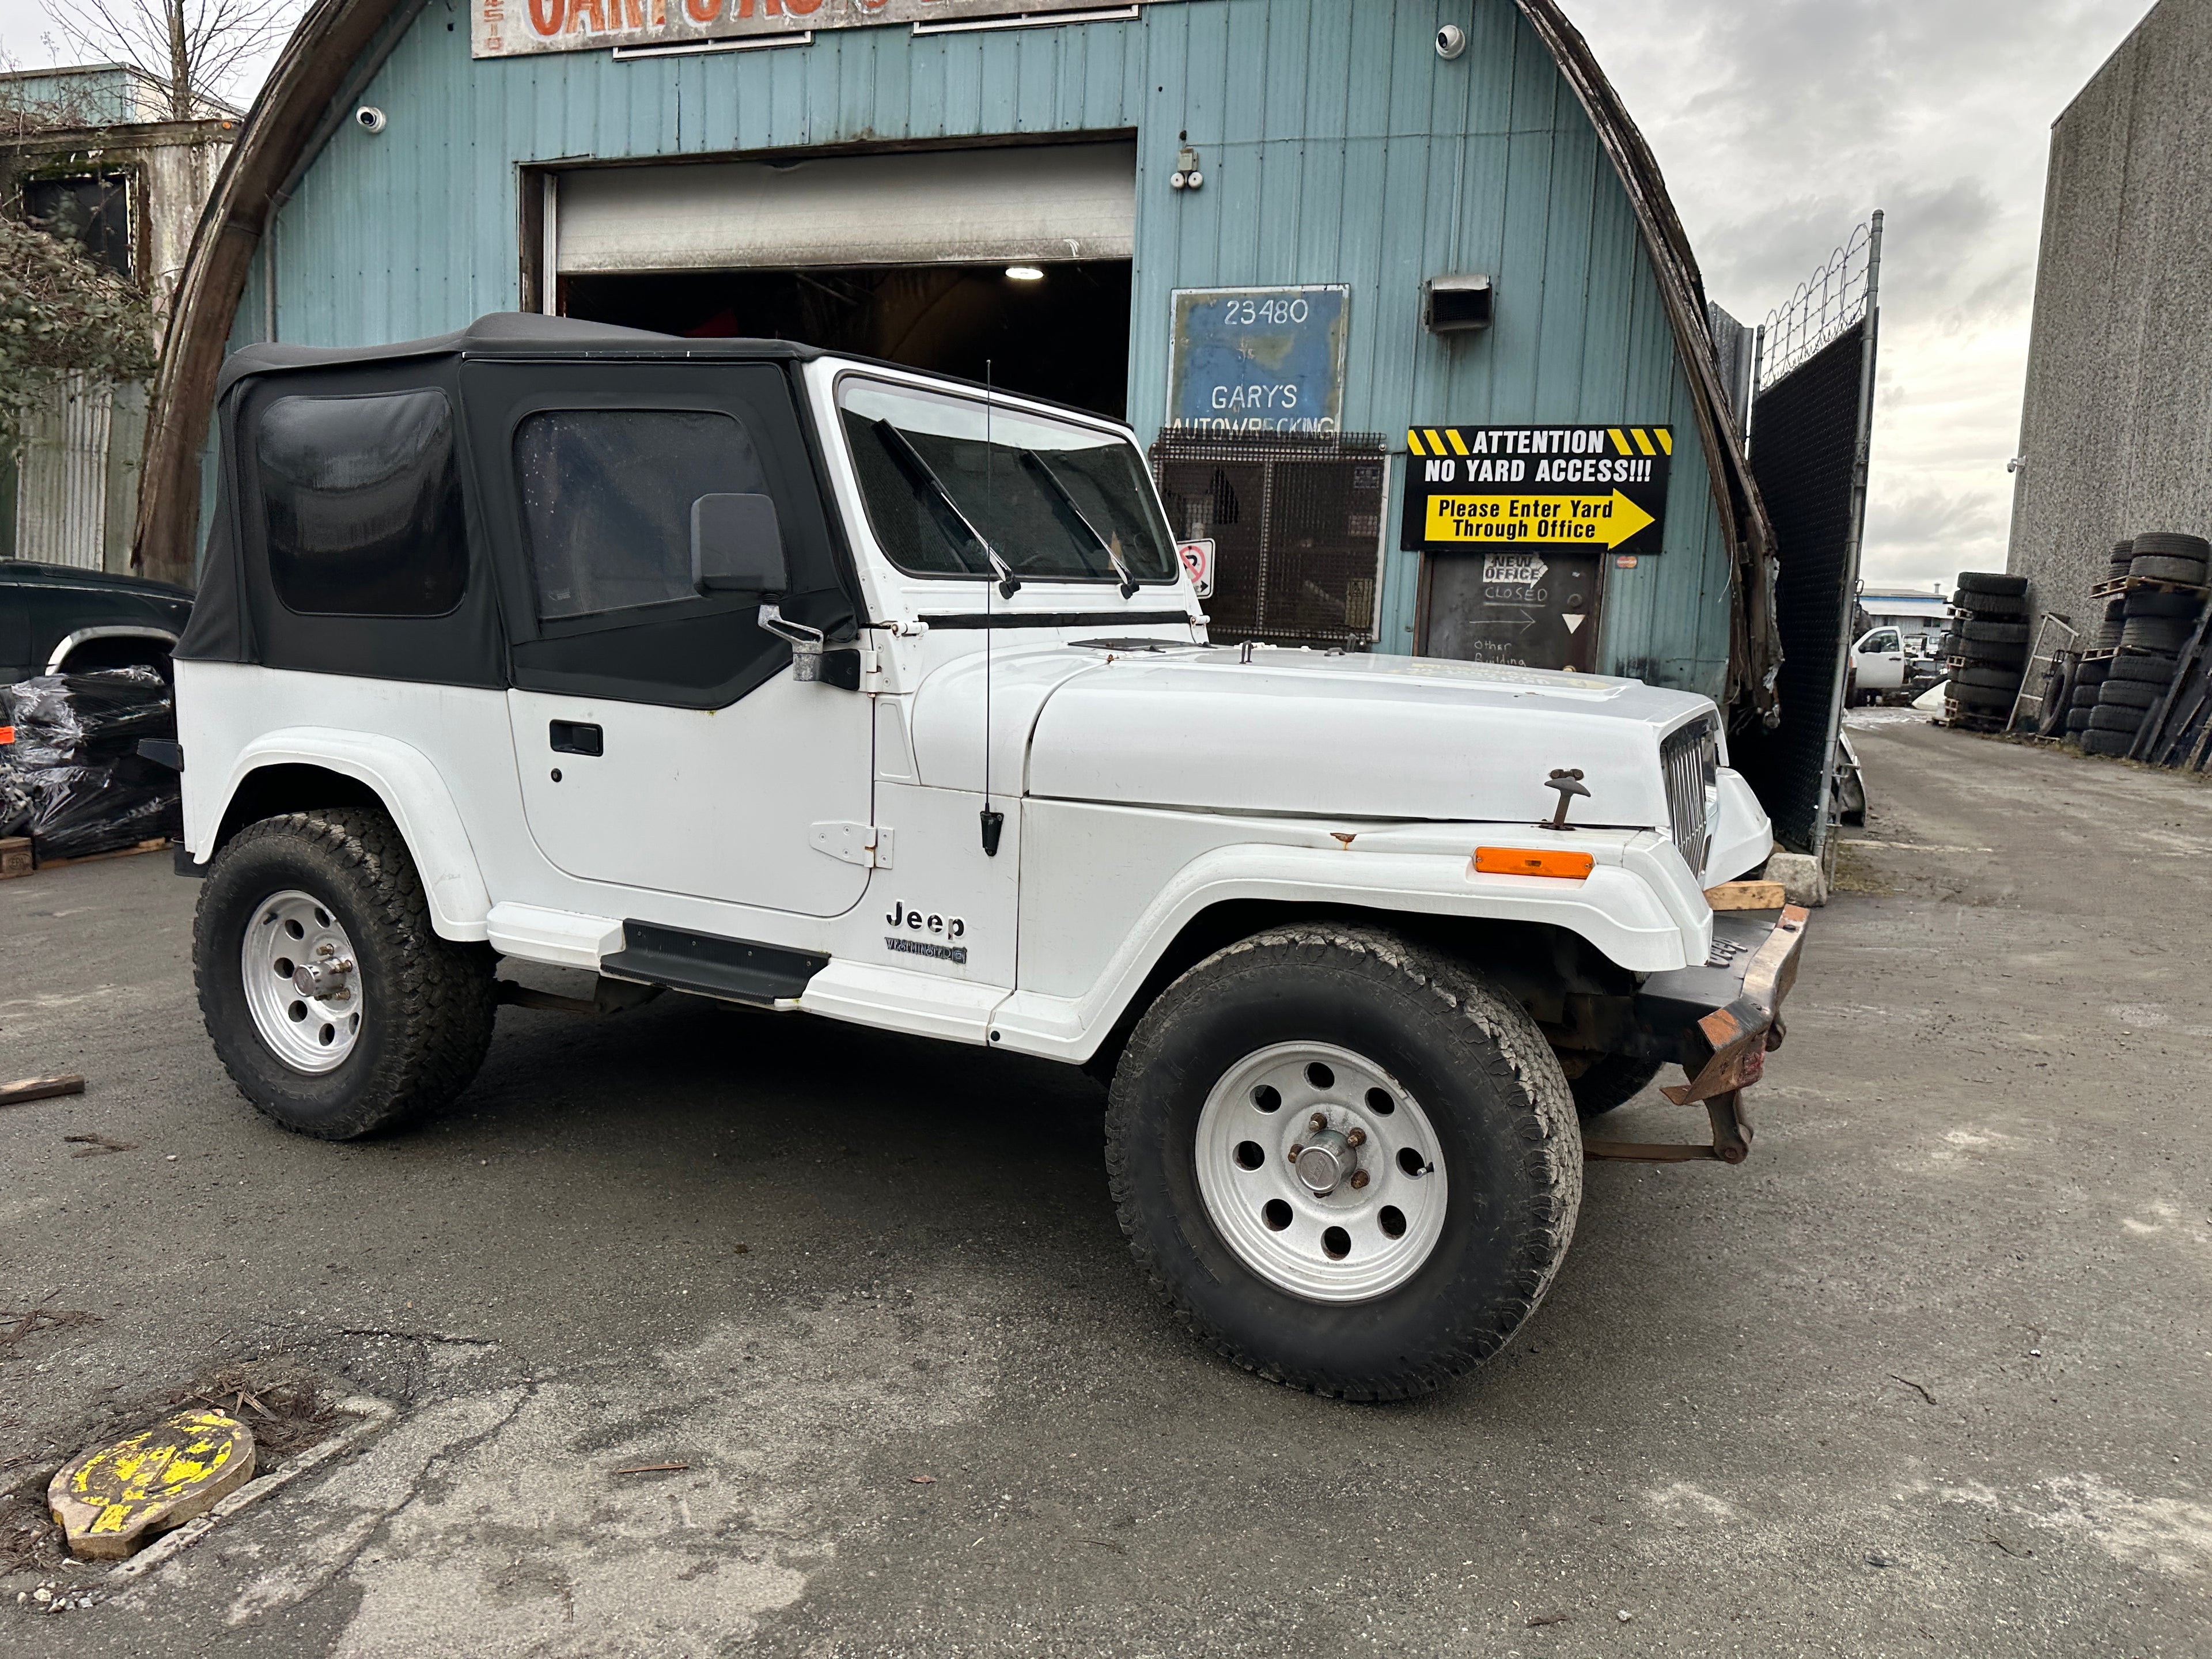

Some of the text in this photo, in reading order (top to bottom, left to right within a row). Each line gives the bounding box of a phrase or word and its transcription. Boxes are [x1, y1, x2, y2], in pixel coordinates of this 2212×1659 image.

[1225, 298, 1308, 325] 23480
[1212, 384, 1297, 409] GARY'S
[1472, 430, 1605, 454] ATTENTION
[1425, 459, 1652, 483] NO YARD ACCESS!!!
[1438, 499, 1613, 518] Please Enter Yard
[1452, 519, 1596, 540] Through Office
[1492, 554, 1532, 567] NEW
[1485, 566, 1540, 581] OFFICE
[1485, 586, 1548, 601] CLOSED
[886, 900, 965, 941] Jeep
[885, 937, 952, 960] WESTMINSTER
